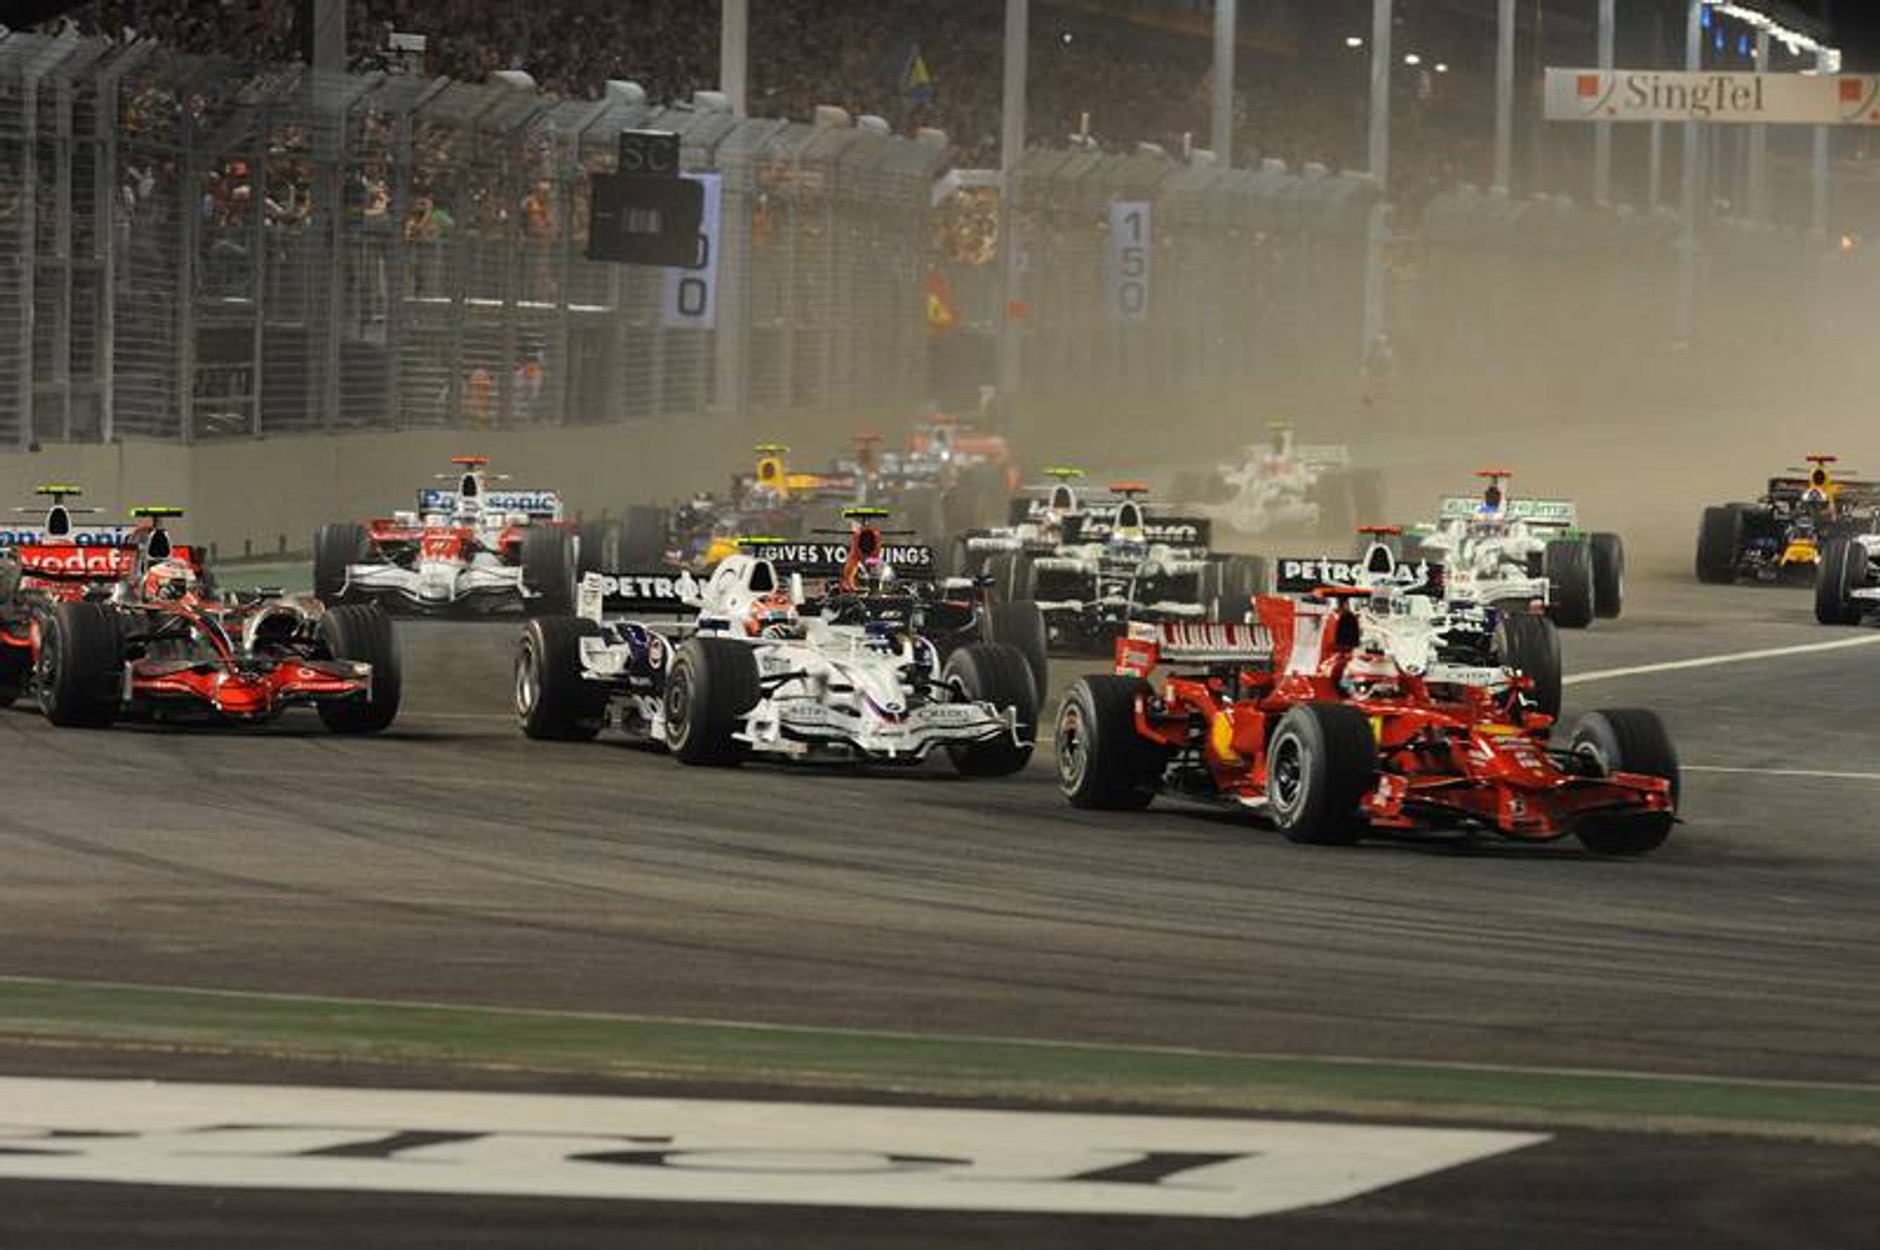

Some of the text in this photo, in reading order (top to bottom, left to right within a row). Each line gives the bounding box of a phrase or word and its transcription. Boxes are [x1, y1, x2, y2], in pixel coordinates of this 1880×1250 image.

[1625, 75, 1764, 117] SingTel
[622, 138, 672, 171] SC
[419, 489, 556, 511] Pasonic
[765, 545, 819, 564] GIVES
[821, 546, 849, 564] YO
[0, 1124, 1258, 1189] Tel
